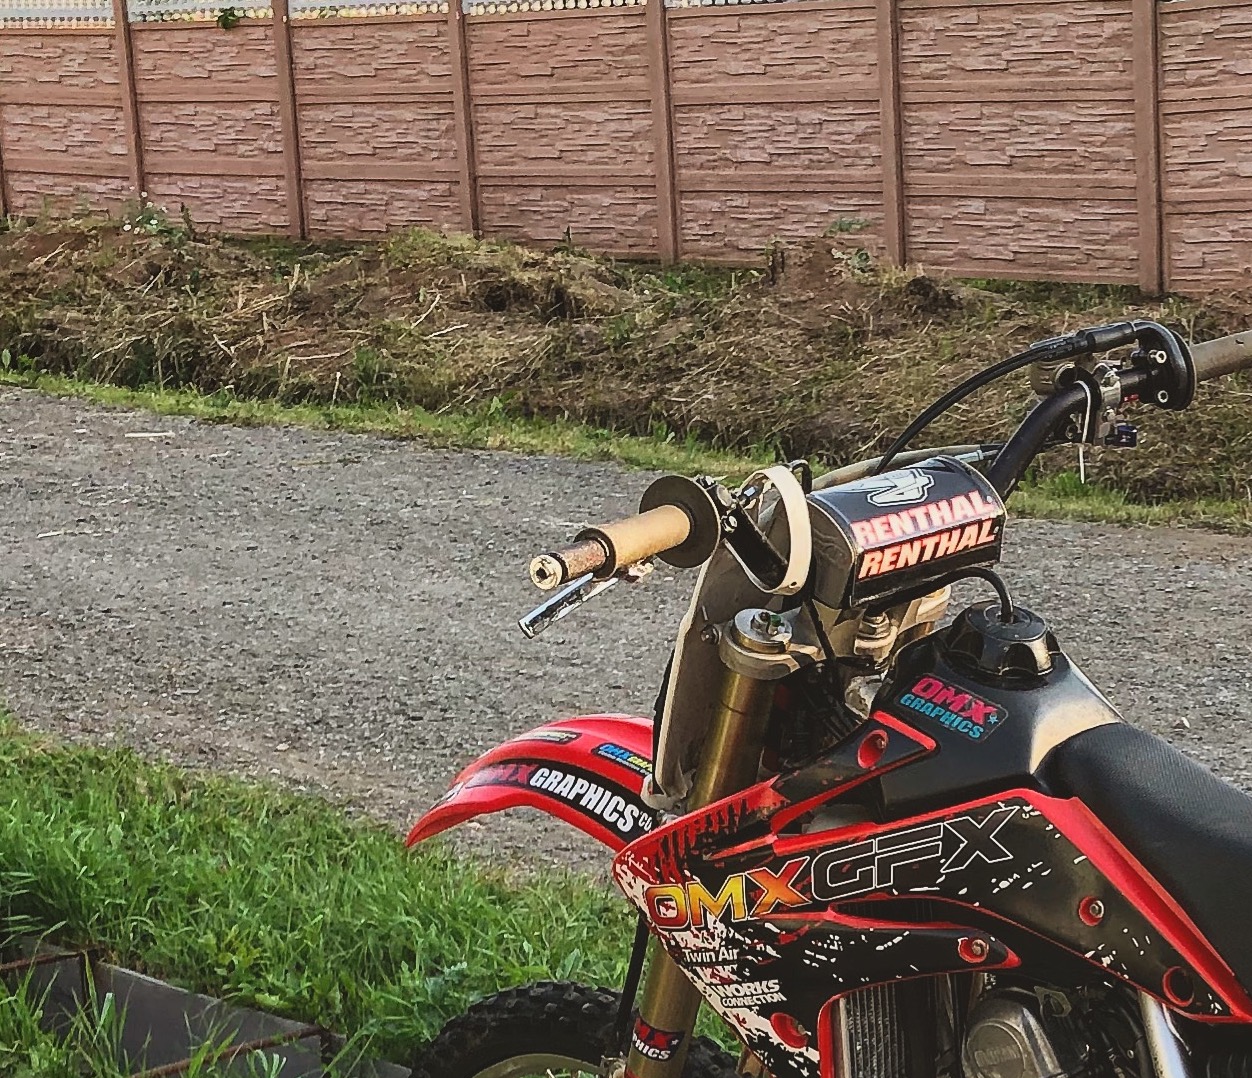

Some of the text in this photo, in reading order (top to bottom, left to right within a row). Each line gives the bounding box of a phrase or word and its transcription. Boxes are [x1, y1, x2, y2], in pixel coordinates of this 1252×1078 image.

[851, 490, 996, 547] RENTHAL
[857, 518, 996, 581] RENTHAL
[900, 694, 985, 739] GRAPHICS
[529, 767, 640, 833] GRAPHICS
[644, 805, 1020, 929] OMX GFX
[682, 945, 740, 963] Twin Air
[710, 979, 781, 998] WORKS
[722, 992, 788, 1007] CONNECTION
